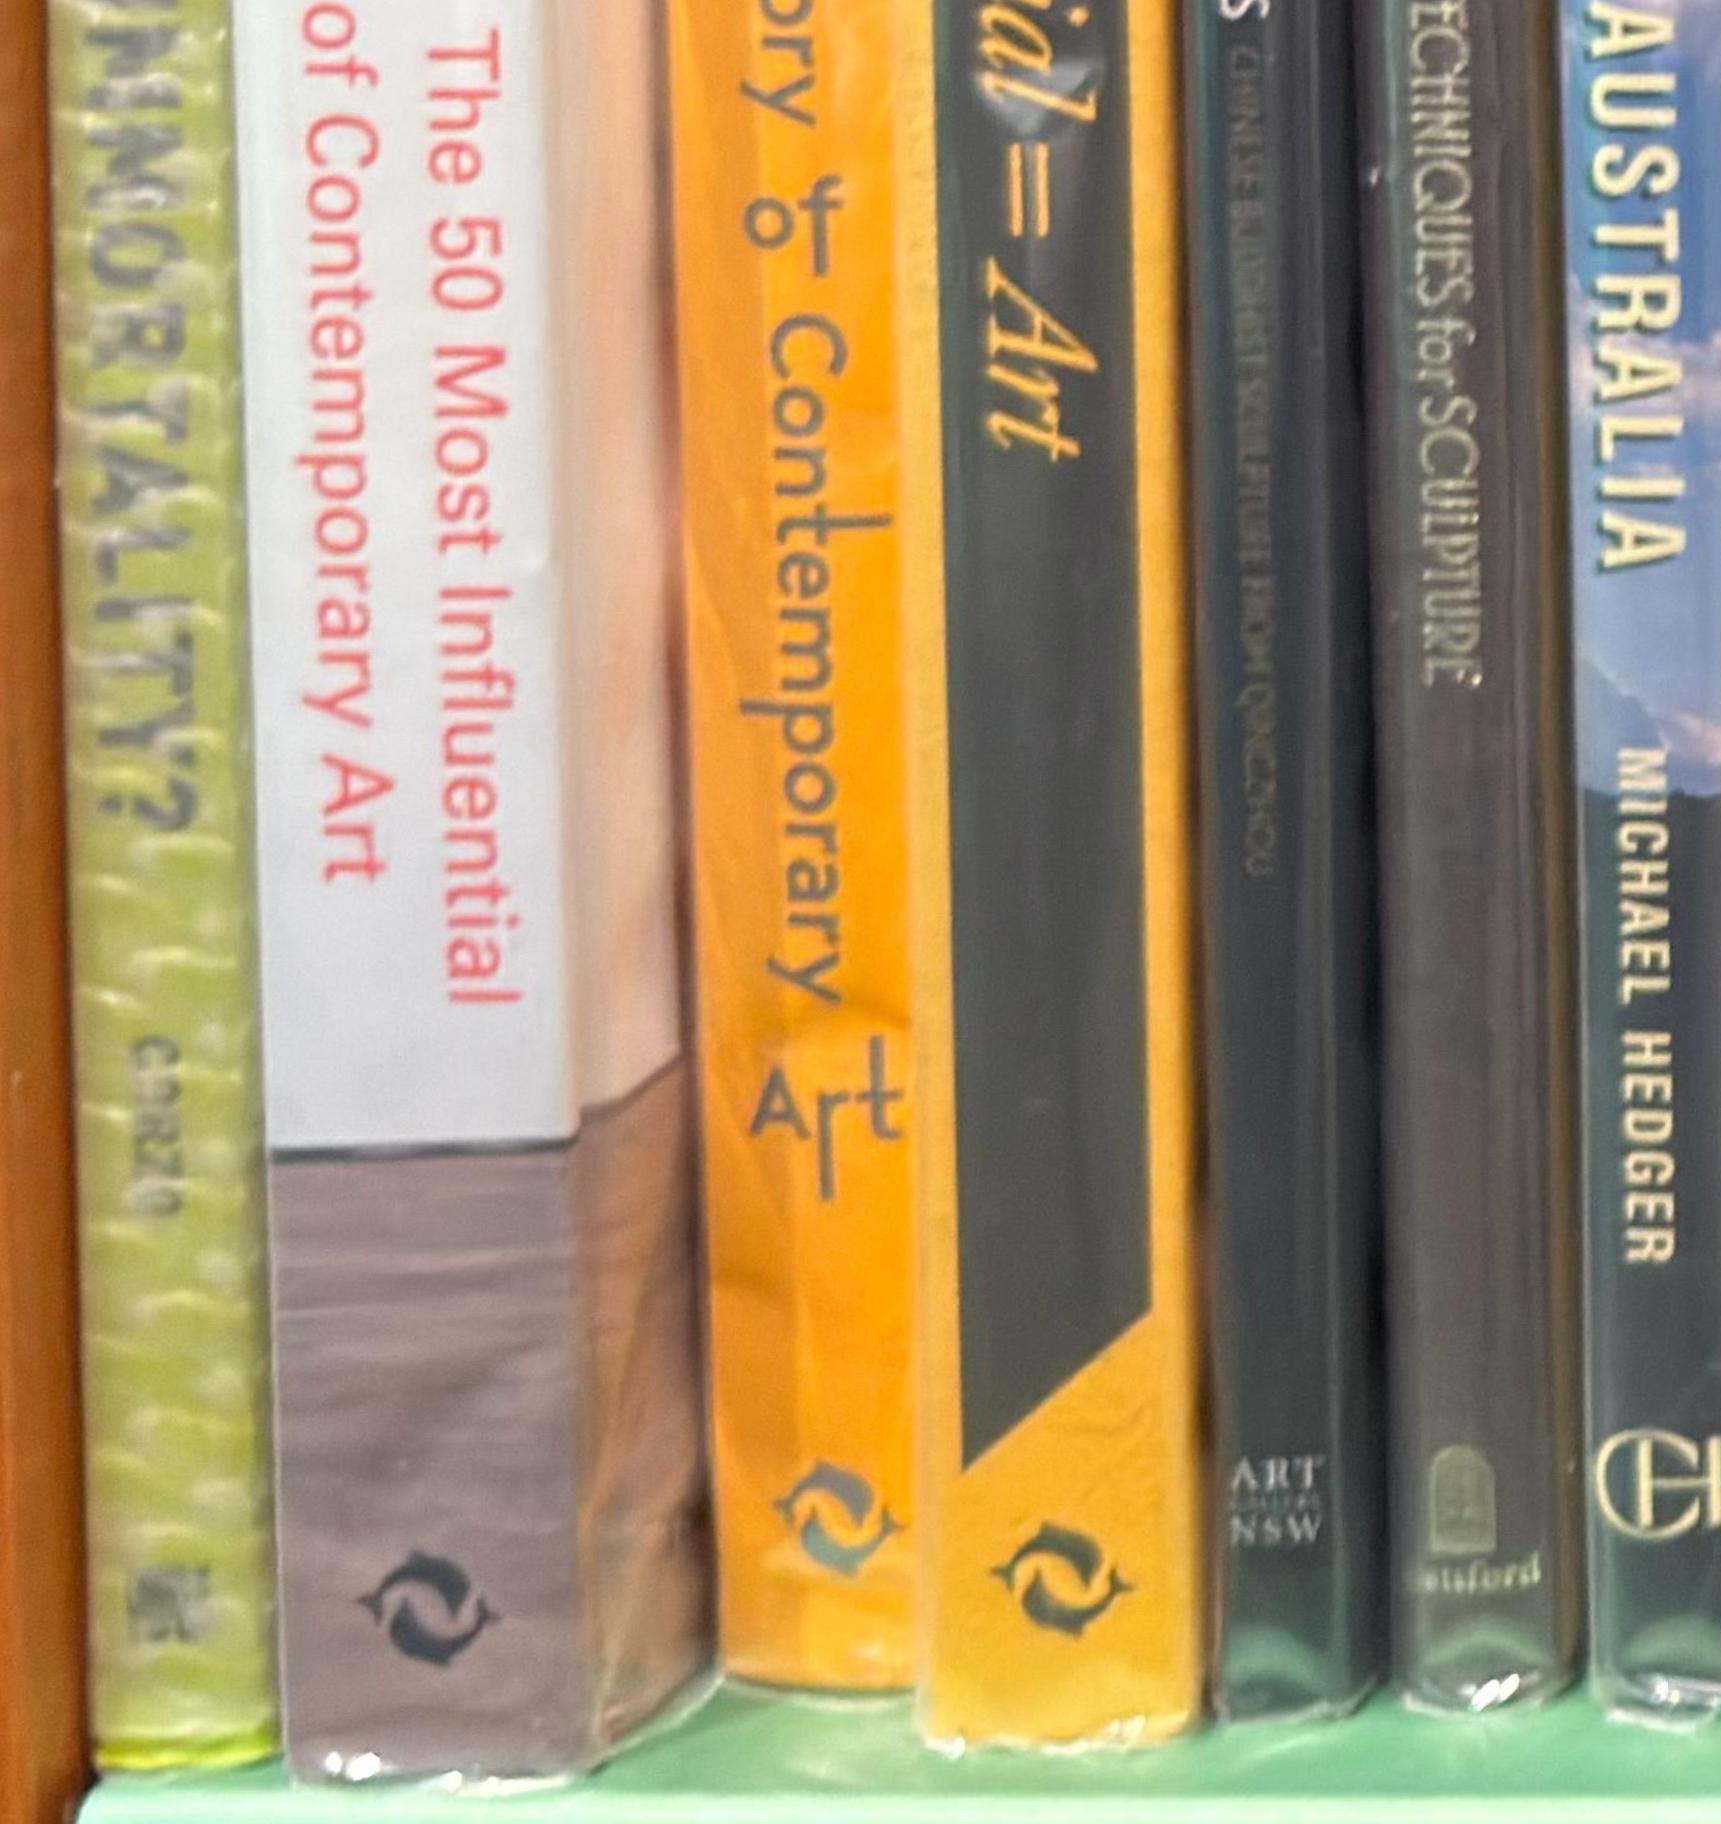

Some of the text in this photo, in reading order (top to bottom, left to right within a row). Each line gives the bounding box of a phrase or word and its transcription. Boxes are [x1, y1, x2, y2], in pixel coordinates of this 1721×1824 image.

[300, 0, 380, 88] of
[427, 27, 502, 186] The
[428, 214, 505, 314] 50
[741, 173, 844, 279] of
[1588, 0, 1687, 572] AUSTRALIA
[293, 112, 381, 730] Contemporary
[983, 255, 1099, 464] Art
[1416, 318, 1475, 395] for
[433, 343, 508, 556] Most
[1414, 396, 1483, 691] SCULPTURE
[737, 311, 893, 1007] Contemporary
[320, 751, 395, 886] Art
[437, 586, 523, 1005] Influential
[1616, 747, 1676, 1268] MICHAEL HEDGER
[748, 1033, 905, 1203] Art
[1225, 1453, 1328, 1492] ART
[1225, 1512, 1325, 1548] NSW
